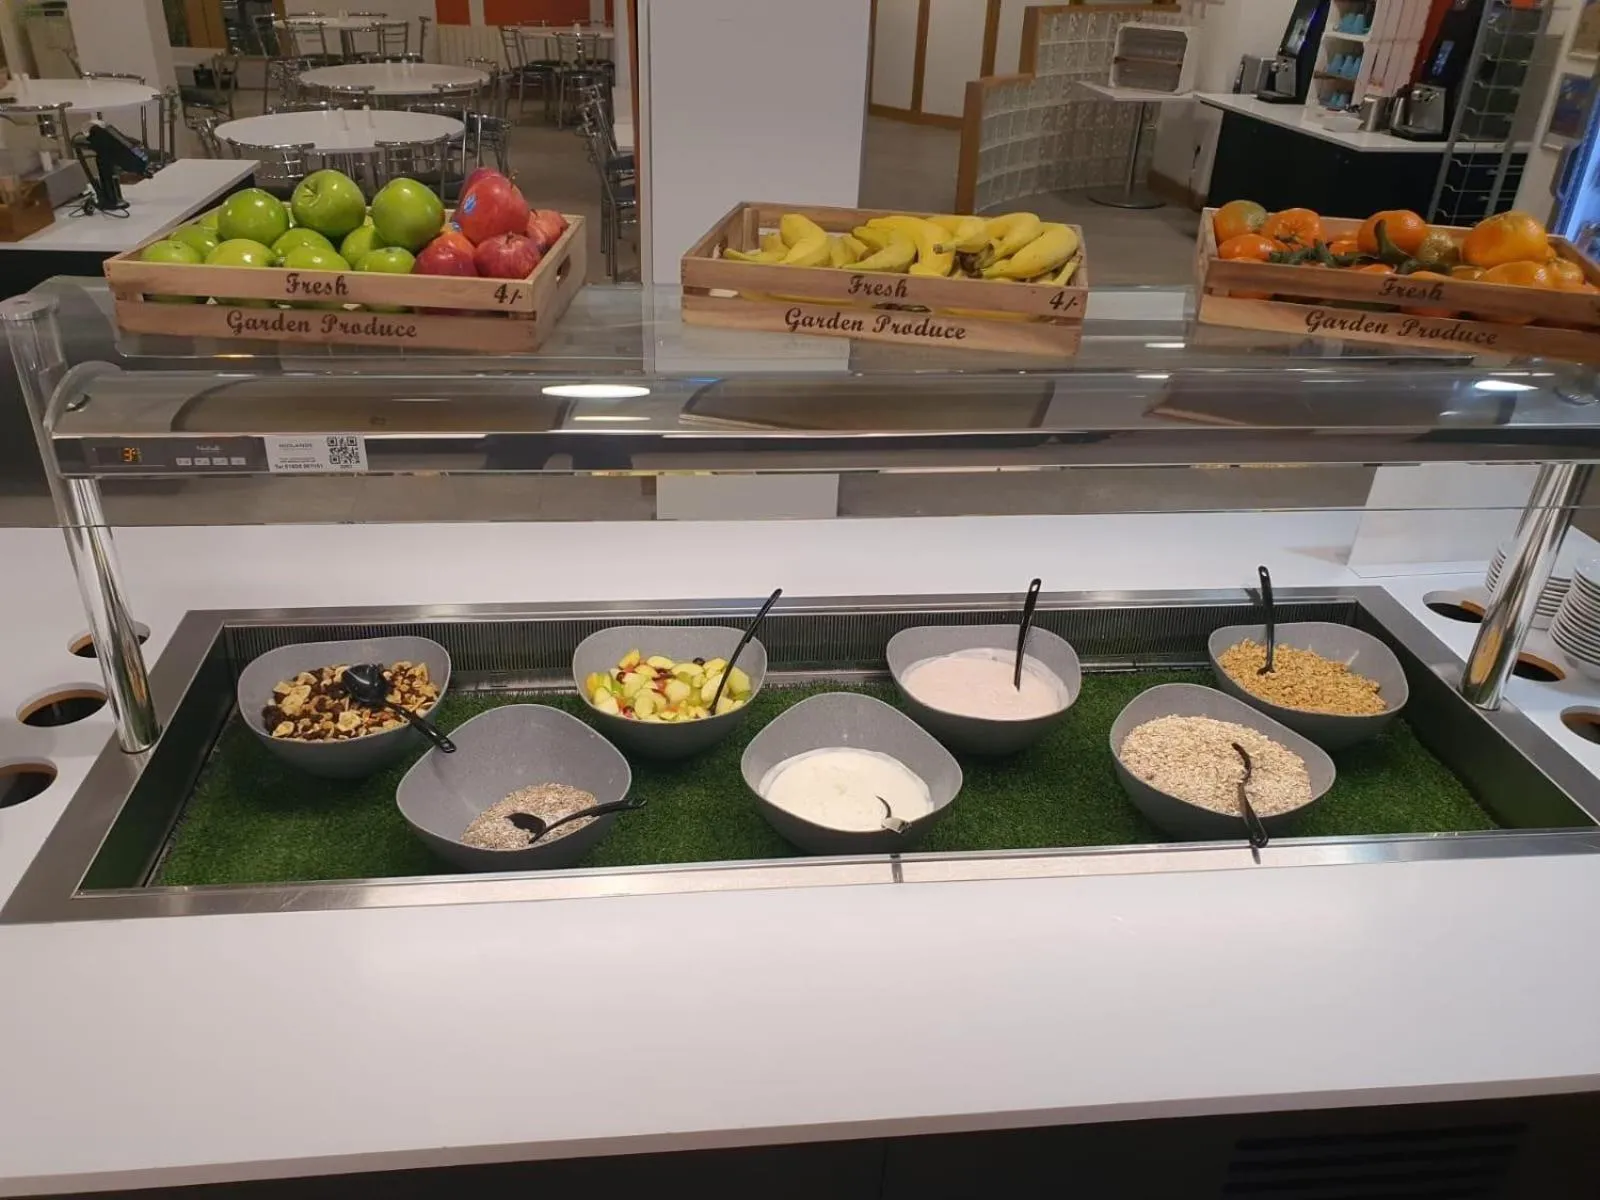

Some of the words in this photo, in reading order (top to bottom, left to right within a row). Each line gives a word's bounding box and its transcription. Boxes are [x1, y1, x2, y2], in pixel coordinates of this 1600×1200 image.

[286, 272, 349, 296] Fresh
[847, 275, 908, 298] Fresh
[1377, 278, 1445, 301] Fresh
[226, 310, 311, 335] Garden
[321, 313, 417, 338] Produce
[784, 307, 864, 333] Garden
[872, 314, 966, 340] Produce
[1305, 310, 1389, 334] Garden
[1396, 318, 1499, 345] Produce
